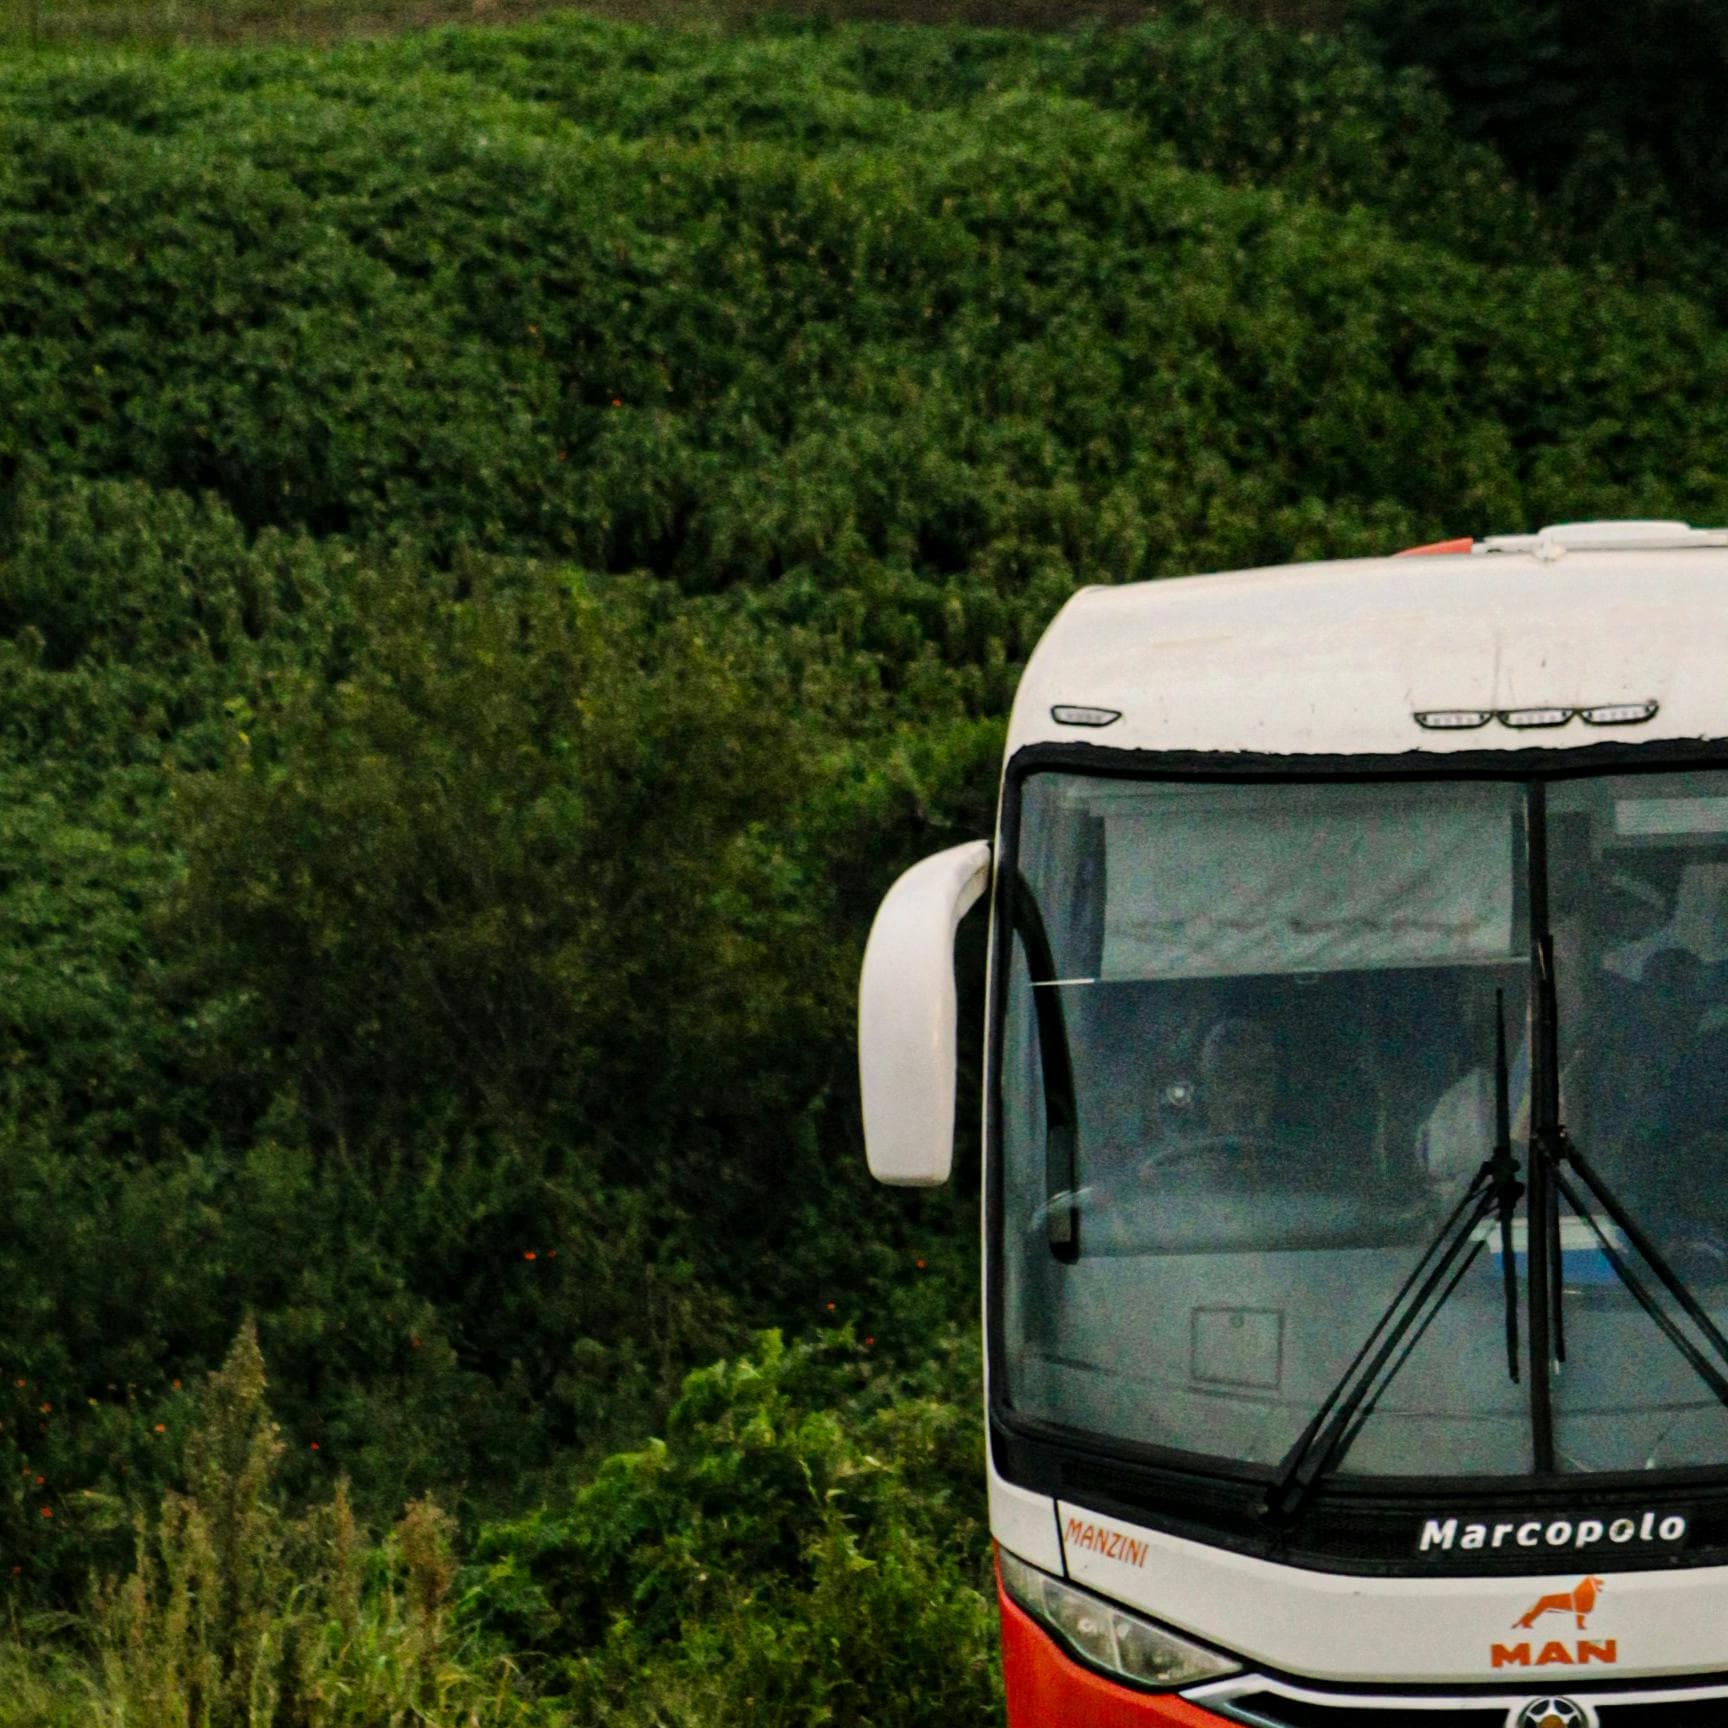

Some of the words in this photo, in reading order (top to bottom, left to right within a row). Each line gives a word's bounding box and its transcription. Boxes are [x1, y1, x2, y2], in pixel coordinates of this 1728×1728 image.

[1064, 1517, 1150, 1568] MANZINI
[1419, 1512, 1687, 1551] Marcopolo
[1490, 1638, 1617, 1669] MAN
